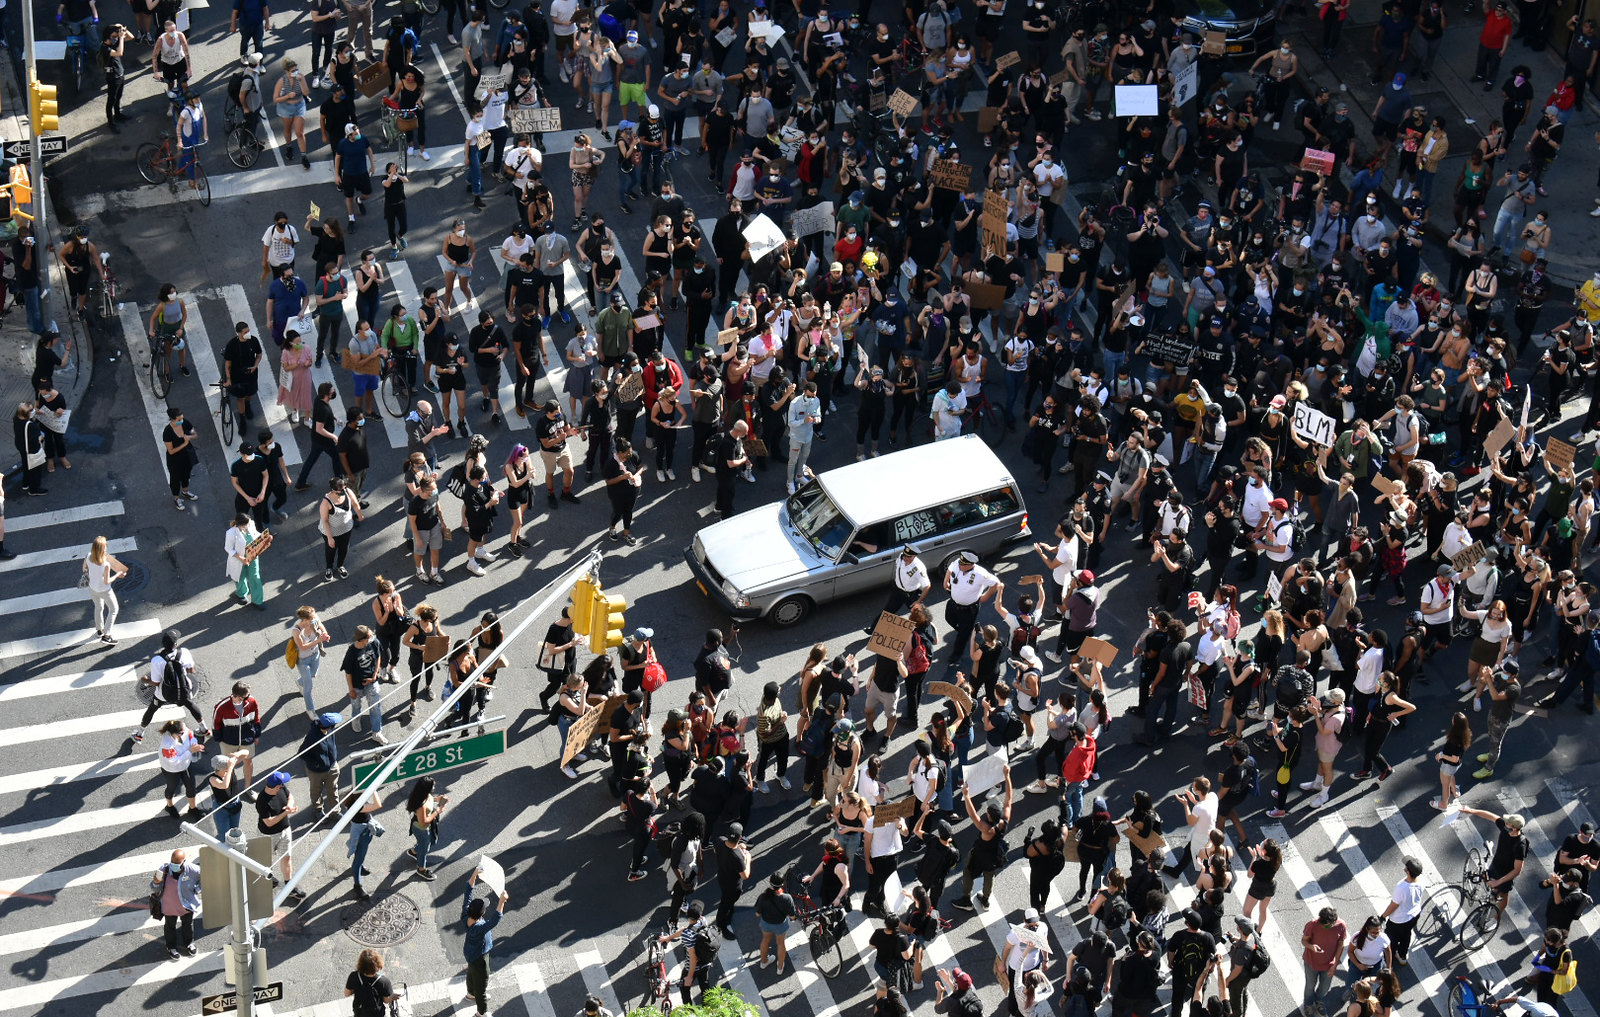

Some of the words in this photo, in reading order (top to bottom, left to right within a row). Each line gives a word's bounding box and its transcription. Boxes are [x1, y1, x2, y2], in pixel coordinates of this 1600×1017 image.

[513, 109, 535, 121] KILL
[540, 108, 559, 120] THE
[515, 120, 559, 132] SYSTEM
[13, 144, 31, 152] ONE
[1294, 407, 1330, 444] BLM
[1453, 543, 1485, 570] MAMA!
[881, 612, 915, 631] POLICE
[870, 631, 907, 652] POLICE!
[396, 759, 407, 777] E
[415, 752, 438, 772] 28
[445, 746, 464, 763] St
[212, 997, 237, 1008] ONE
